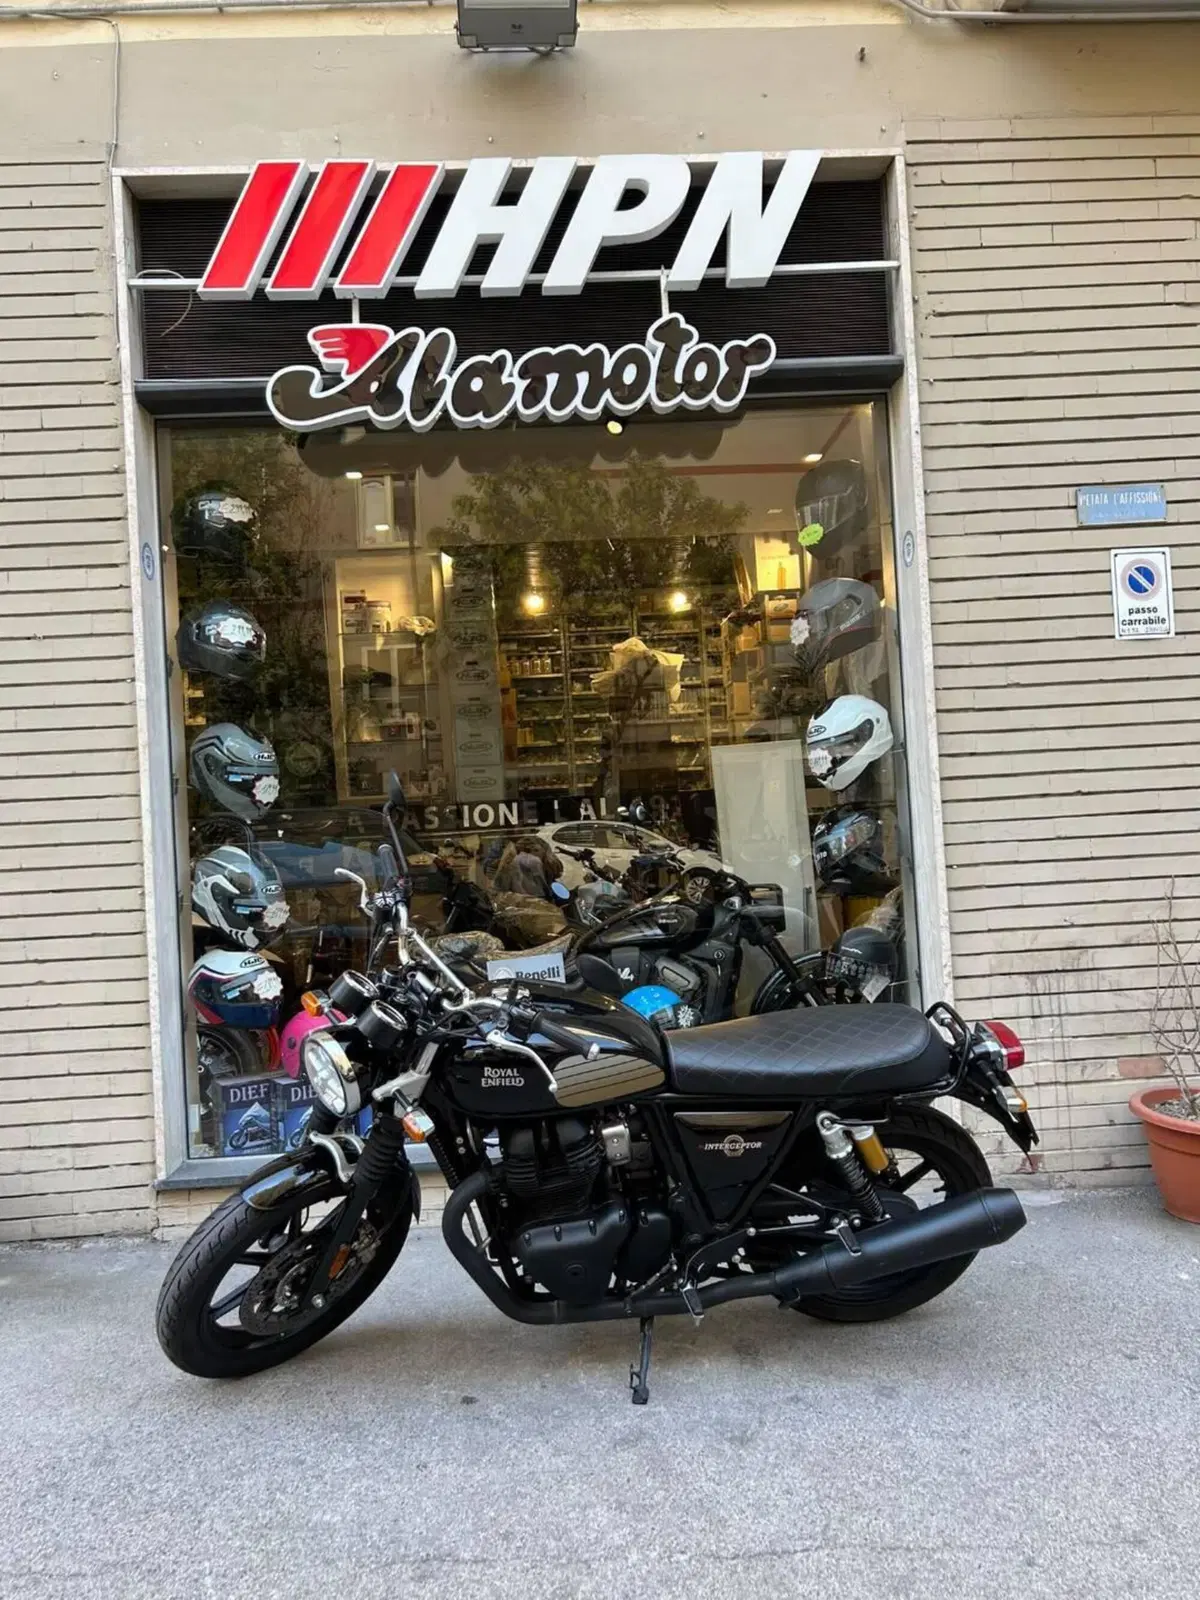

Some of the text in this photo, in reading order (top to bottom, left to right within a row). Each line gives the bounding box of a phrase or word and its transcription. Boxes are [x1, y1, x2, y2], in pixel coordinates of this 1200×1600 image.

[415, 150, 822, 298] HPN
[1128, 606, 1158, 616] passo
[1121, 616, 1167, 626] carrabile
[515, 966, 561, 980] Benelli
[484, 1066, 520, 1078] ROYAL
[481, 1077, 525, 1087] ENFIELD
[704, 1141, 763, 1150] INTERCEPTOR
